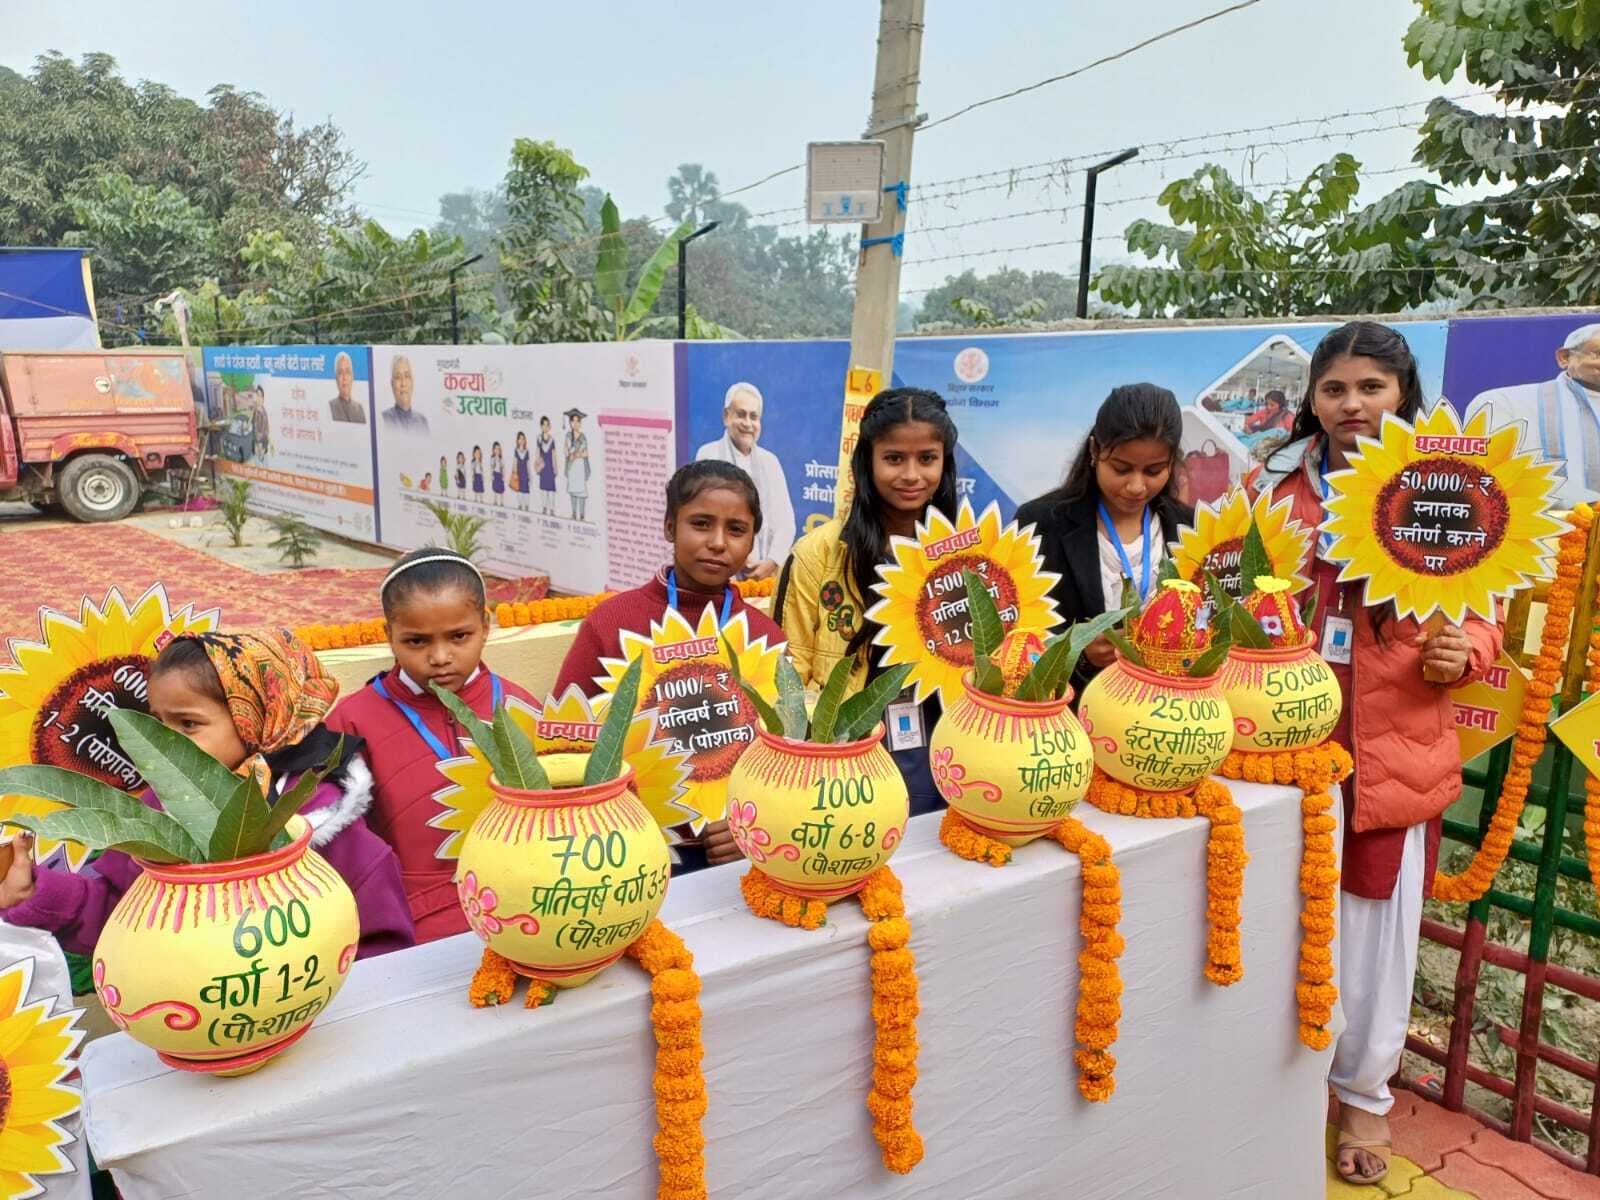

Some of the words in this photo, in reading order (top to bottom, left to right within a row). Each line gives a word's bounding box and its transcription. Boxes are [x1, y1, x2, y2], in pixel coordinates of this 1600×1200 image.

[443, 371, 486, 393] कन्या
[456, 394, 508, 418] उत्थान
[1415, 435, 1490, 456] धन्यवाद
[804, 459, 839, 480] प्रोत्सा
[1399, 471, 1474, 493] 50,000/-
[1413, 500, 1472, 519] स्नातक
[924, 527, 981, 560] धन्यवाद
[1391, 522, 1442, 544] उत्तीर्ण
[1446, 526, 1488, 548] करने
[1423, 555, 1448, 572] पर
[926, 572, 968, 601] 1500
[930, 597, 971, 626] प्रतिव
[652, 636, 719, 663] धन्यवाद
[78, 686, 120, 720] प्रति
[654, 674, 713, 703] 1000/-
[658, 700, 711, 730] प्रतिवर्ष
[713, 694, 740, 718] वर्ग
[1150, 694, 1221, 723] 25,000
[1272, 692, 1333, 724] स्नातक
[1452, 702, 1499, 732] जना
[536, 720, 602, 743] धन्यवा
[688, 724, 755, 754] (पोशाक)
[1030, 728, 1077, 757] 1500
[1252, 723, 1313, 748] उत्तीर्ण
[76, 732, 144, 791] (पोशाक)
[1017, 754, 1075, 794] प्रतिवर्ष
[1119, 753, 1173, 776] उत्तीर्ण
[811, 774, 875, 811] 1000
[790, 814, 836, 851] वर्ग
[839, 821, 876, 850] 6-8
[546, 829, 627, 876] 700
[801, 851, 881, 876] (पोशाक)
[529, 874, 612, 918] प्रतिवर्ष
[613, 863, 647, 907] वर्ग
[232, 897, 312, 959] 600
[555, 910, 650, 951] (पोशाक)
[199, 958, 269, 1010] वर्ग
[277, 954, 326, 1003] 1-2
[207, 986, 333, 1046] (पोशाक)
